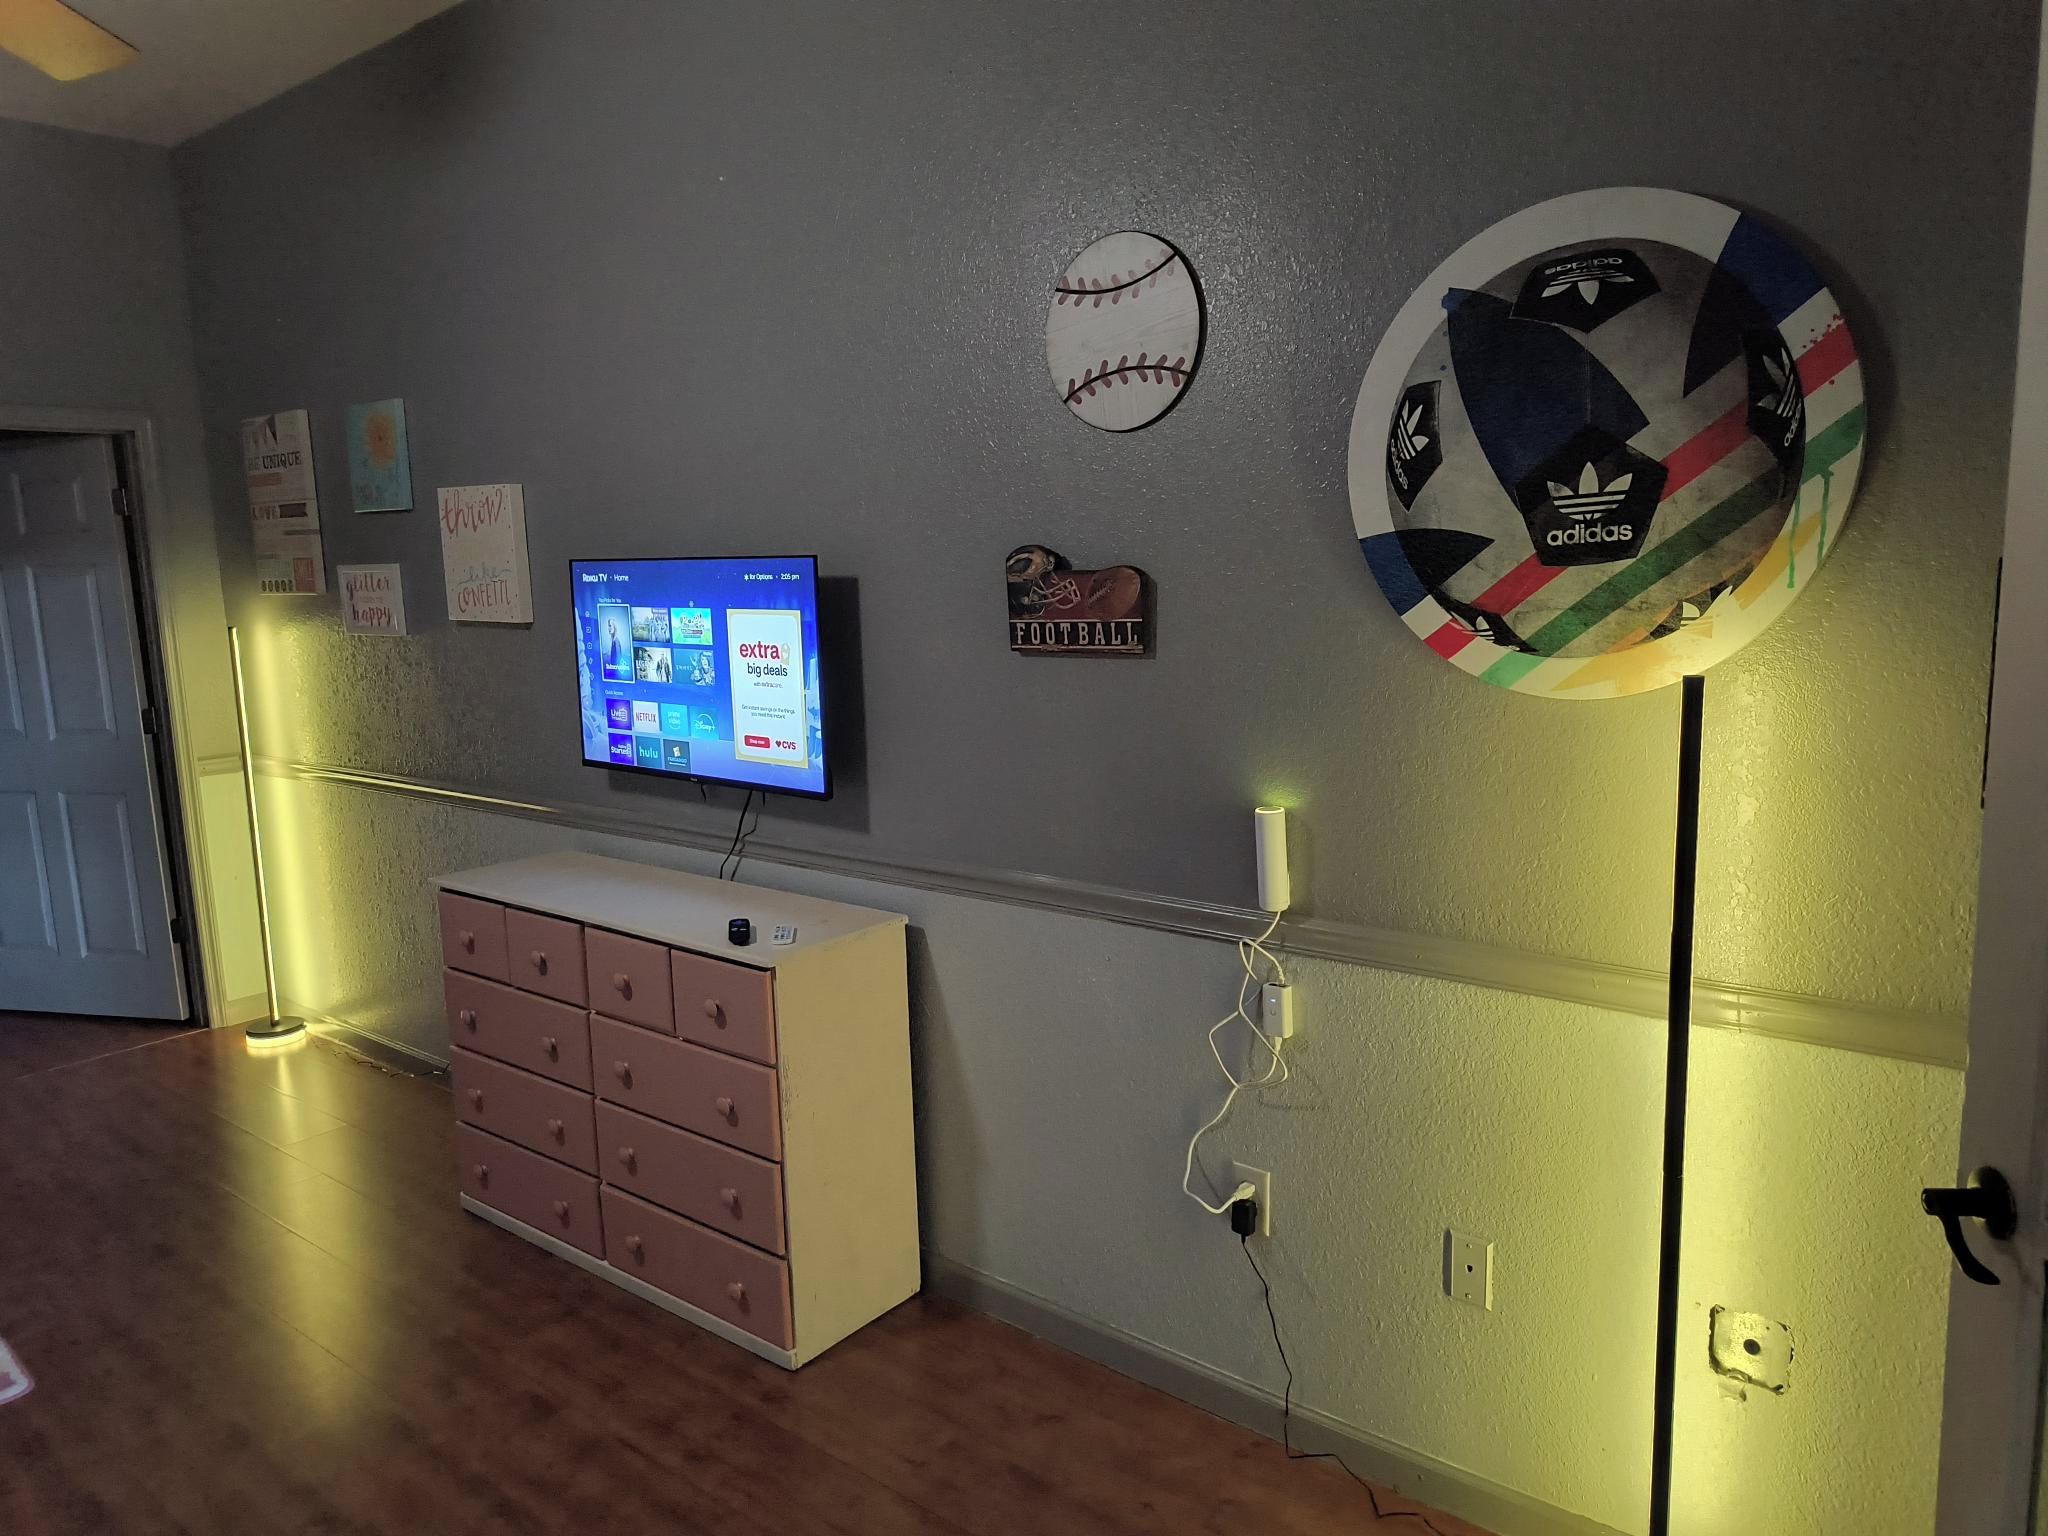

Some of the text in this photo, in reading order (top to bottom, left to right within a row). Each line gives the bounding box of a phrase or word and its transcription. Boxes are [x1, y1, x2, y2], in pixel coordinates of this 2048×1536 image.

[1544, 257, 1623, 275] adidas
[262, 451, 302, 469] UNIQUE
[441, 488, 503, 537] throw
[1547, 522, 1633, 546] adidas
[582, 573, 629, 583] Roku TV Home
[756, 573, 774, 581] Options
[457, 580, 512, 613] CONFETTI
[352, 604, 391, 627] happy
[1016, 622, 1138, 645] FOOTBALL
[739, 641, 780, 660] extra
[747, 662, 788, 678] big deals
[635, 711, 657, 723] NETFLIX
[638, 746, 658, 759] hulu
[782, 740, 797, 750] CVS
